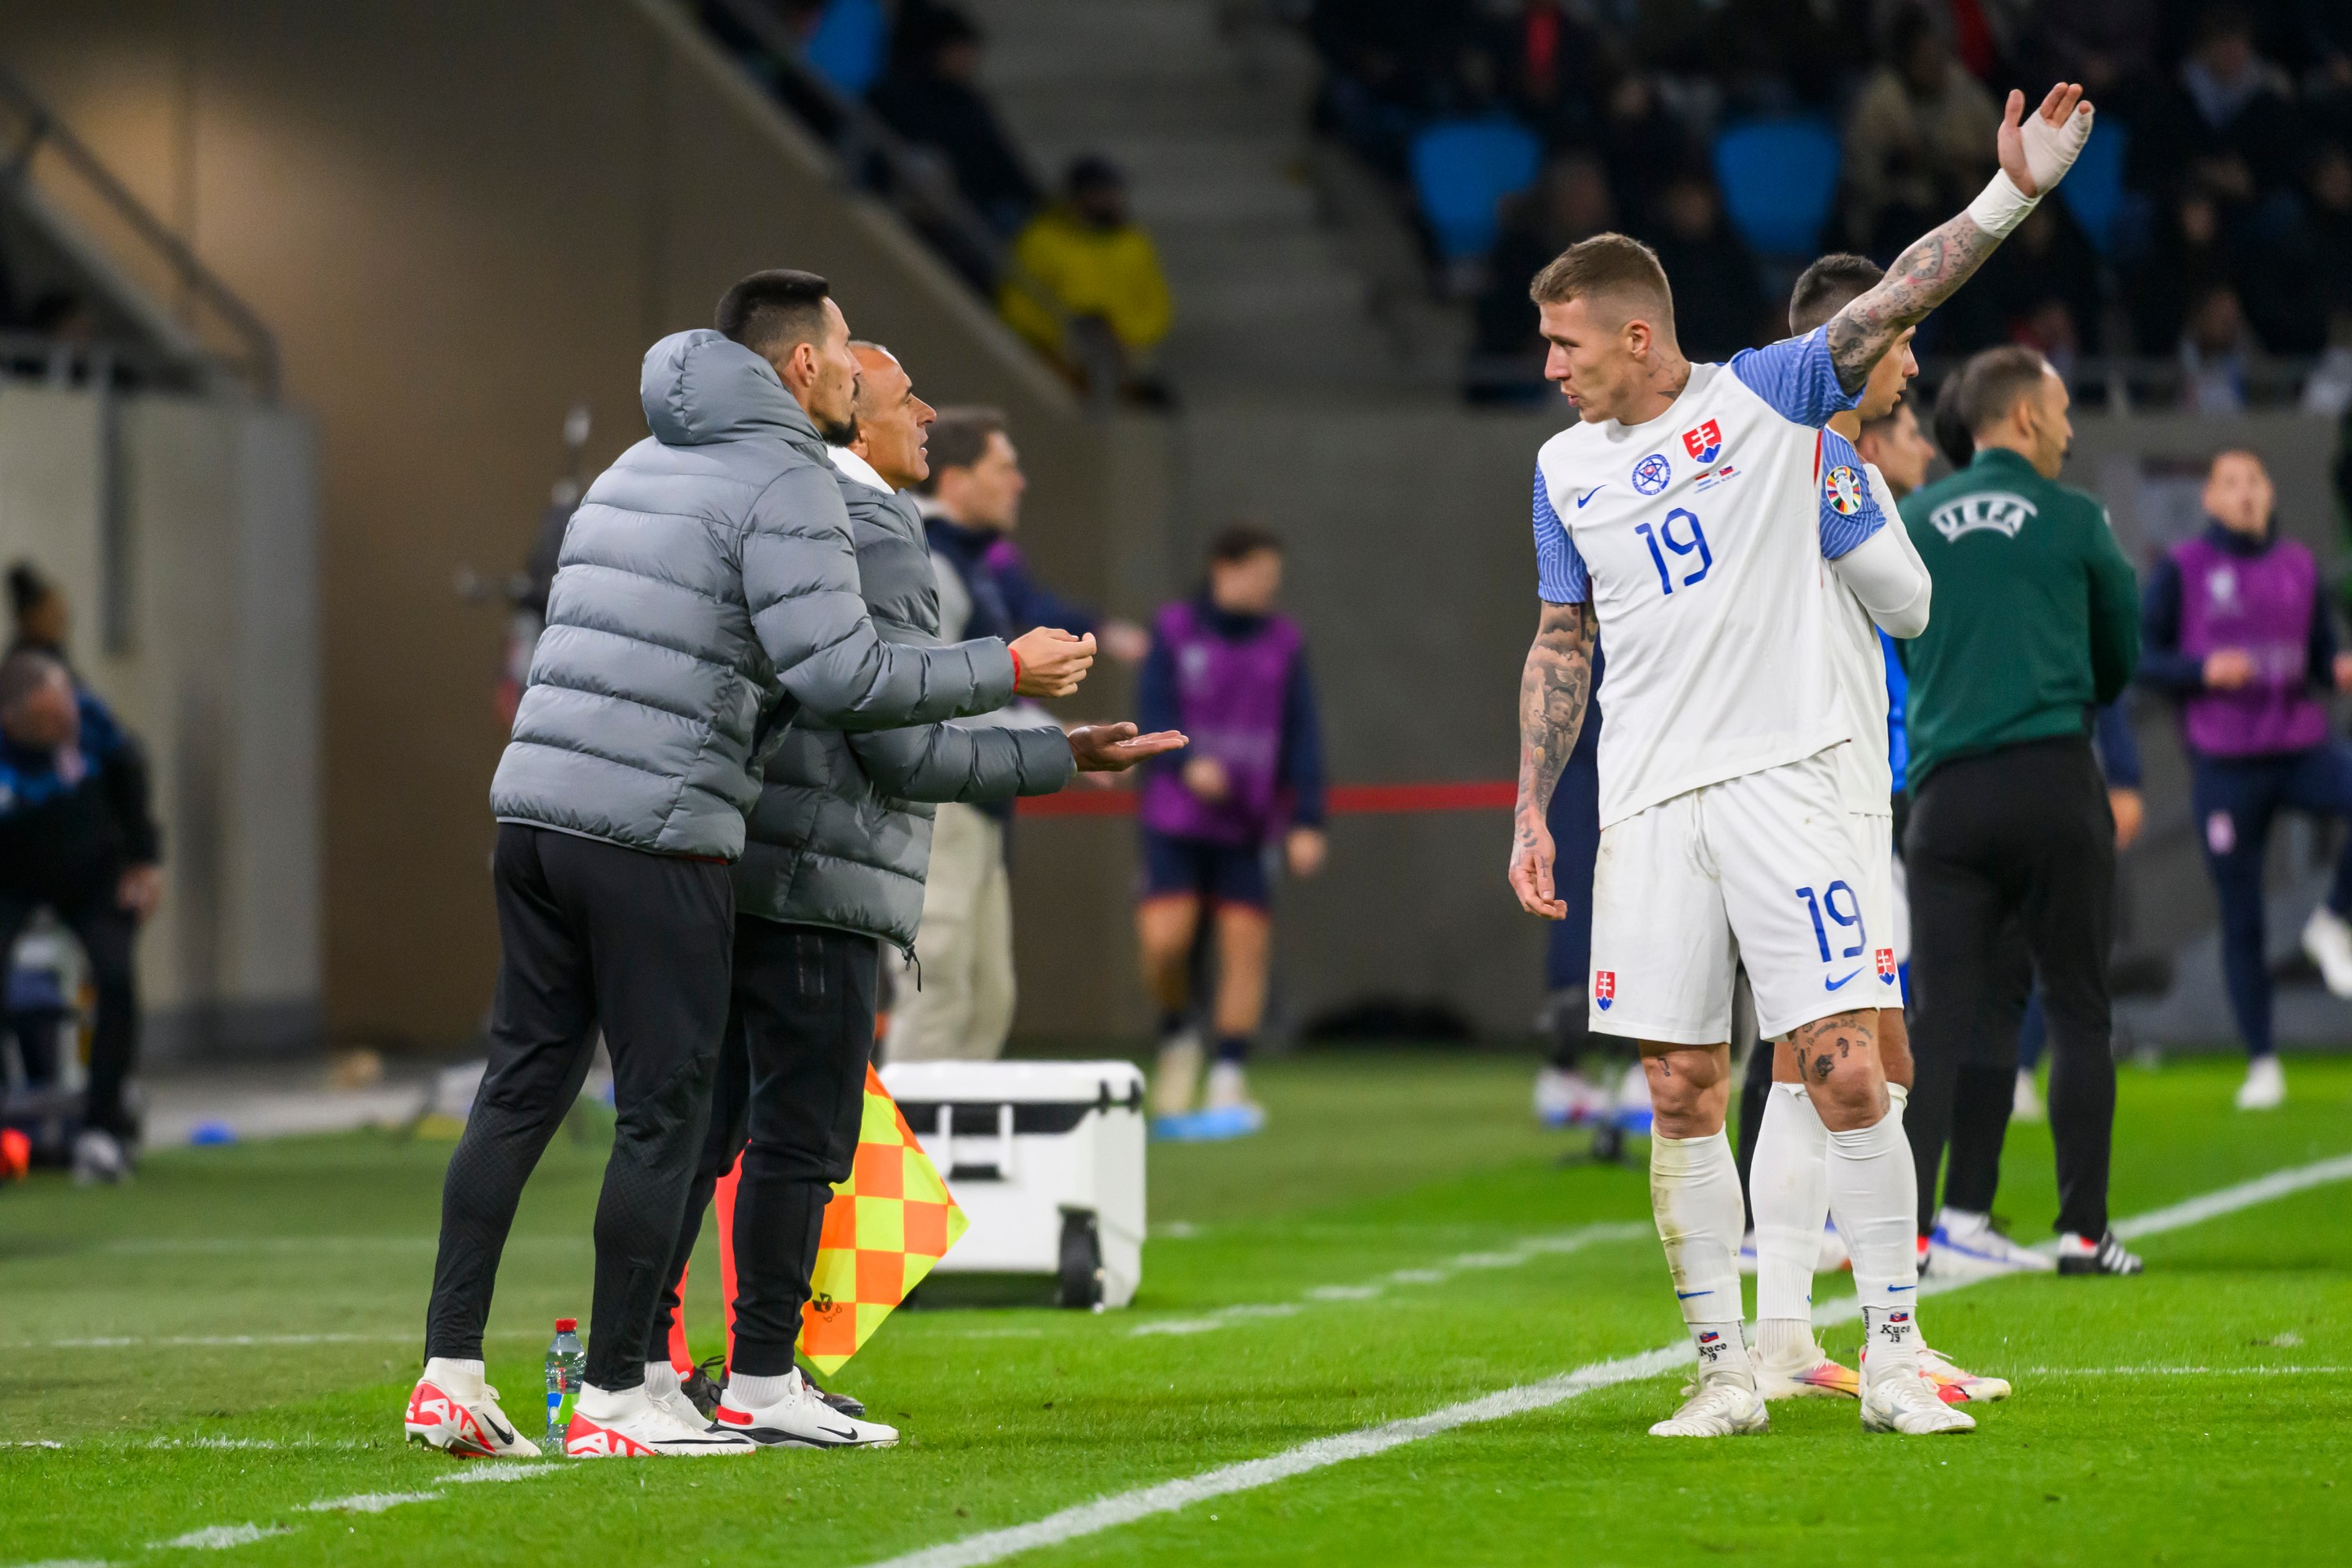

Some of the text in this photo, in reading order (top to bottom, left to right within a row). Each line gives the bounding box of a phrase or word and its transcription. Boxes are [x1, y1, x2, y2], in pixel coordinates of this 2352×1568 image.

[1931, 493, 2032, 541] UEFA
[1634, 507, 1713, 595] 19
[1795, 880, 1867, 963] 19
[1698, 1343, 1727, 1356] Kuco
[1890, 1334, 1900, 1343] 19
[1707, 1352, 1717, 1362] 19
